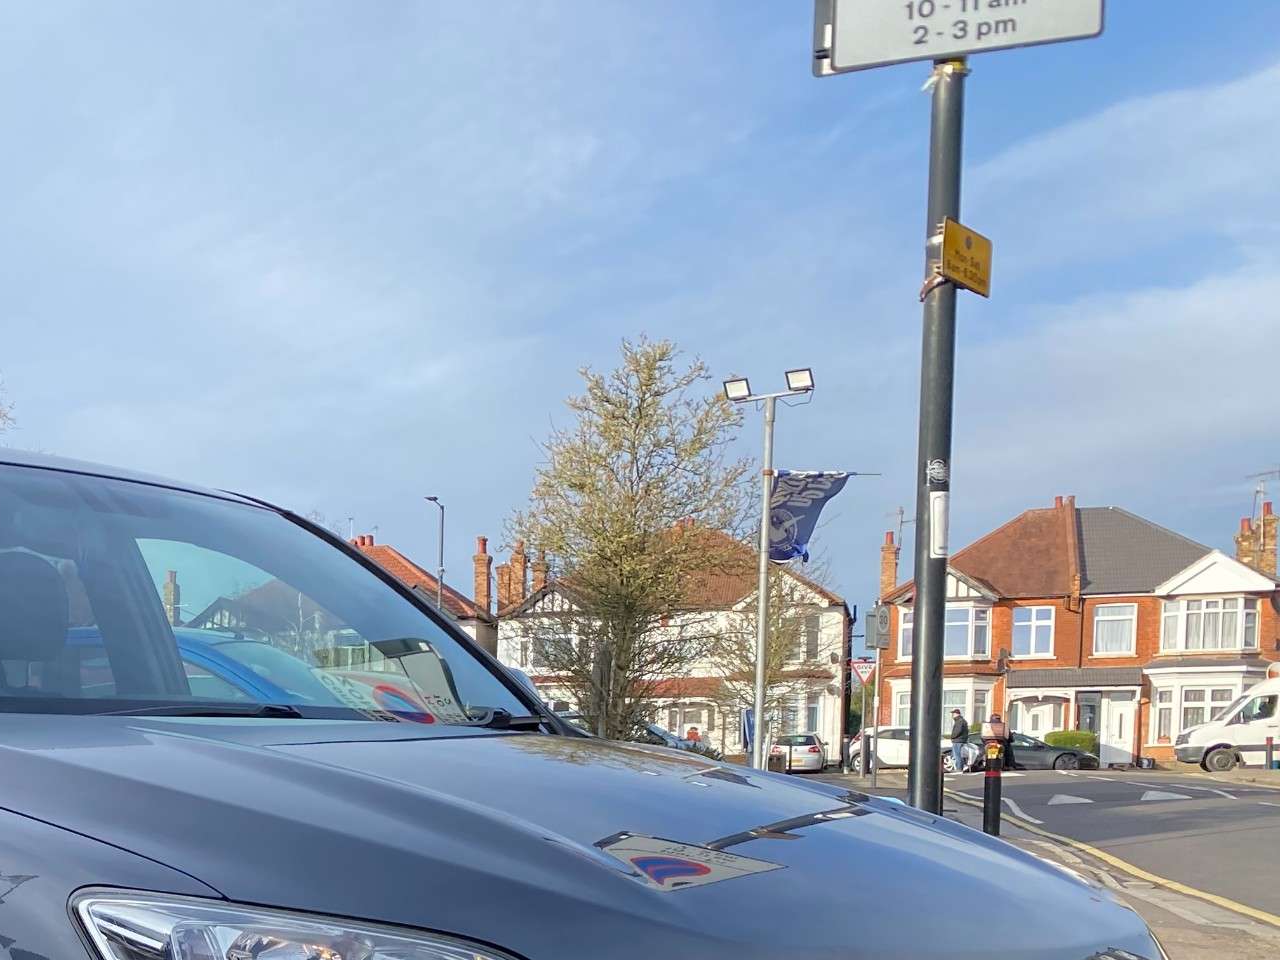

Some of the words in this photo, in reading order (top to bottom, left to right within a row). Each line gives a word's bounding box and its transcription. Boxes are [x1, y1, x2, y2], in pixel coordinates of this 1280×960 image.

[904, 0, 935, 19] 10
[913, 25, 928, 44] 2
[952, 20, 968, 39] 3
[976, 17, 1017, 40] pm
